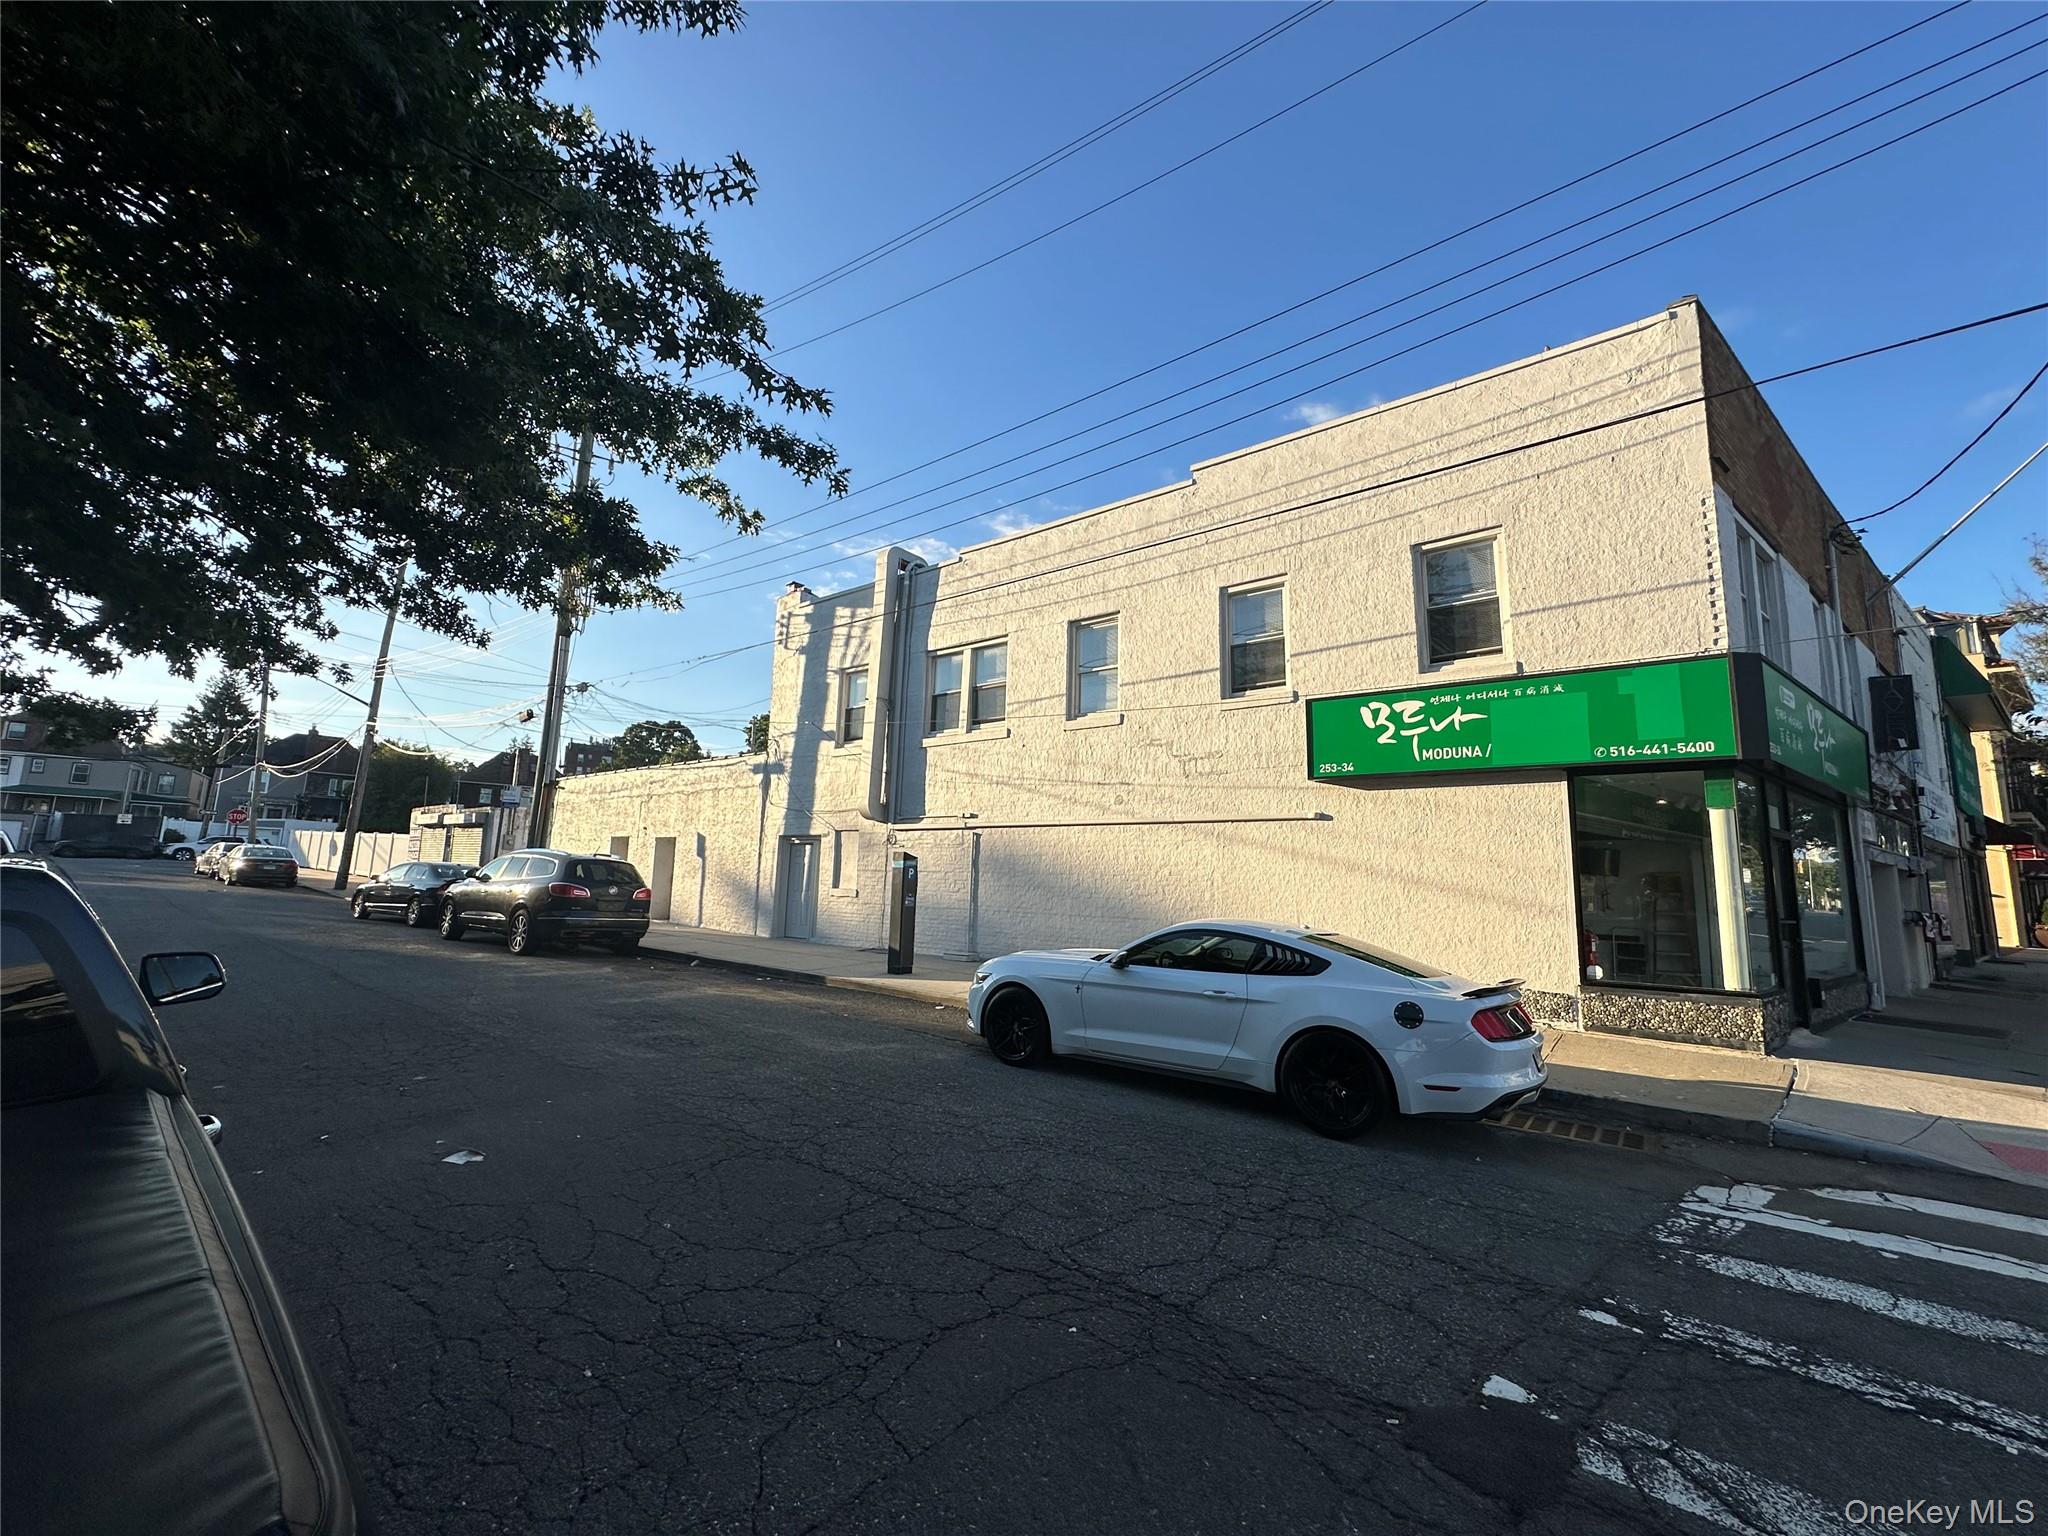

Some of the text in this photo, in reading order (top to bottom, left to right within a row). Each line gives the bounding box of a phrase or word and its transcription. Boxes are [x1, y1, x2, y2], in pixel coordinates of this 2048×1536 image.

[1422, 746, 1483, 761] MODUNA
[1609, 741, 1715, 758] 516-441-5400
[1319, 762, 1354, 773] 253-34
[908, 868, 914, 878] P
